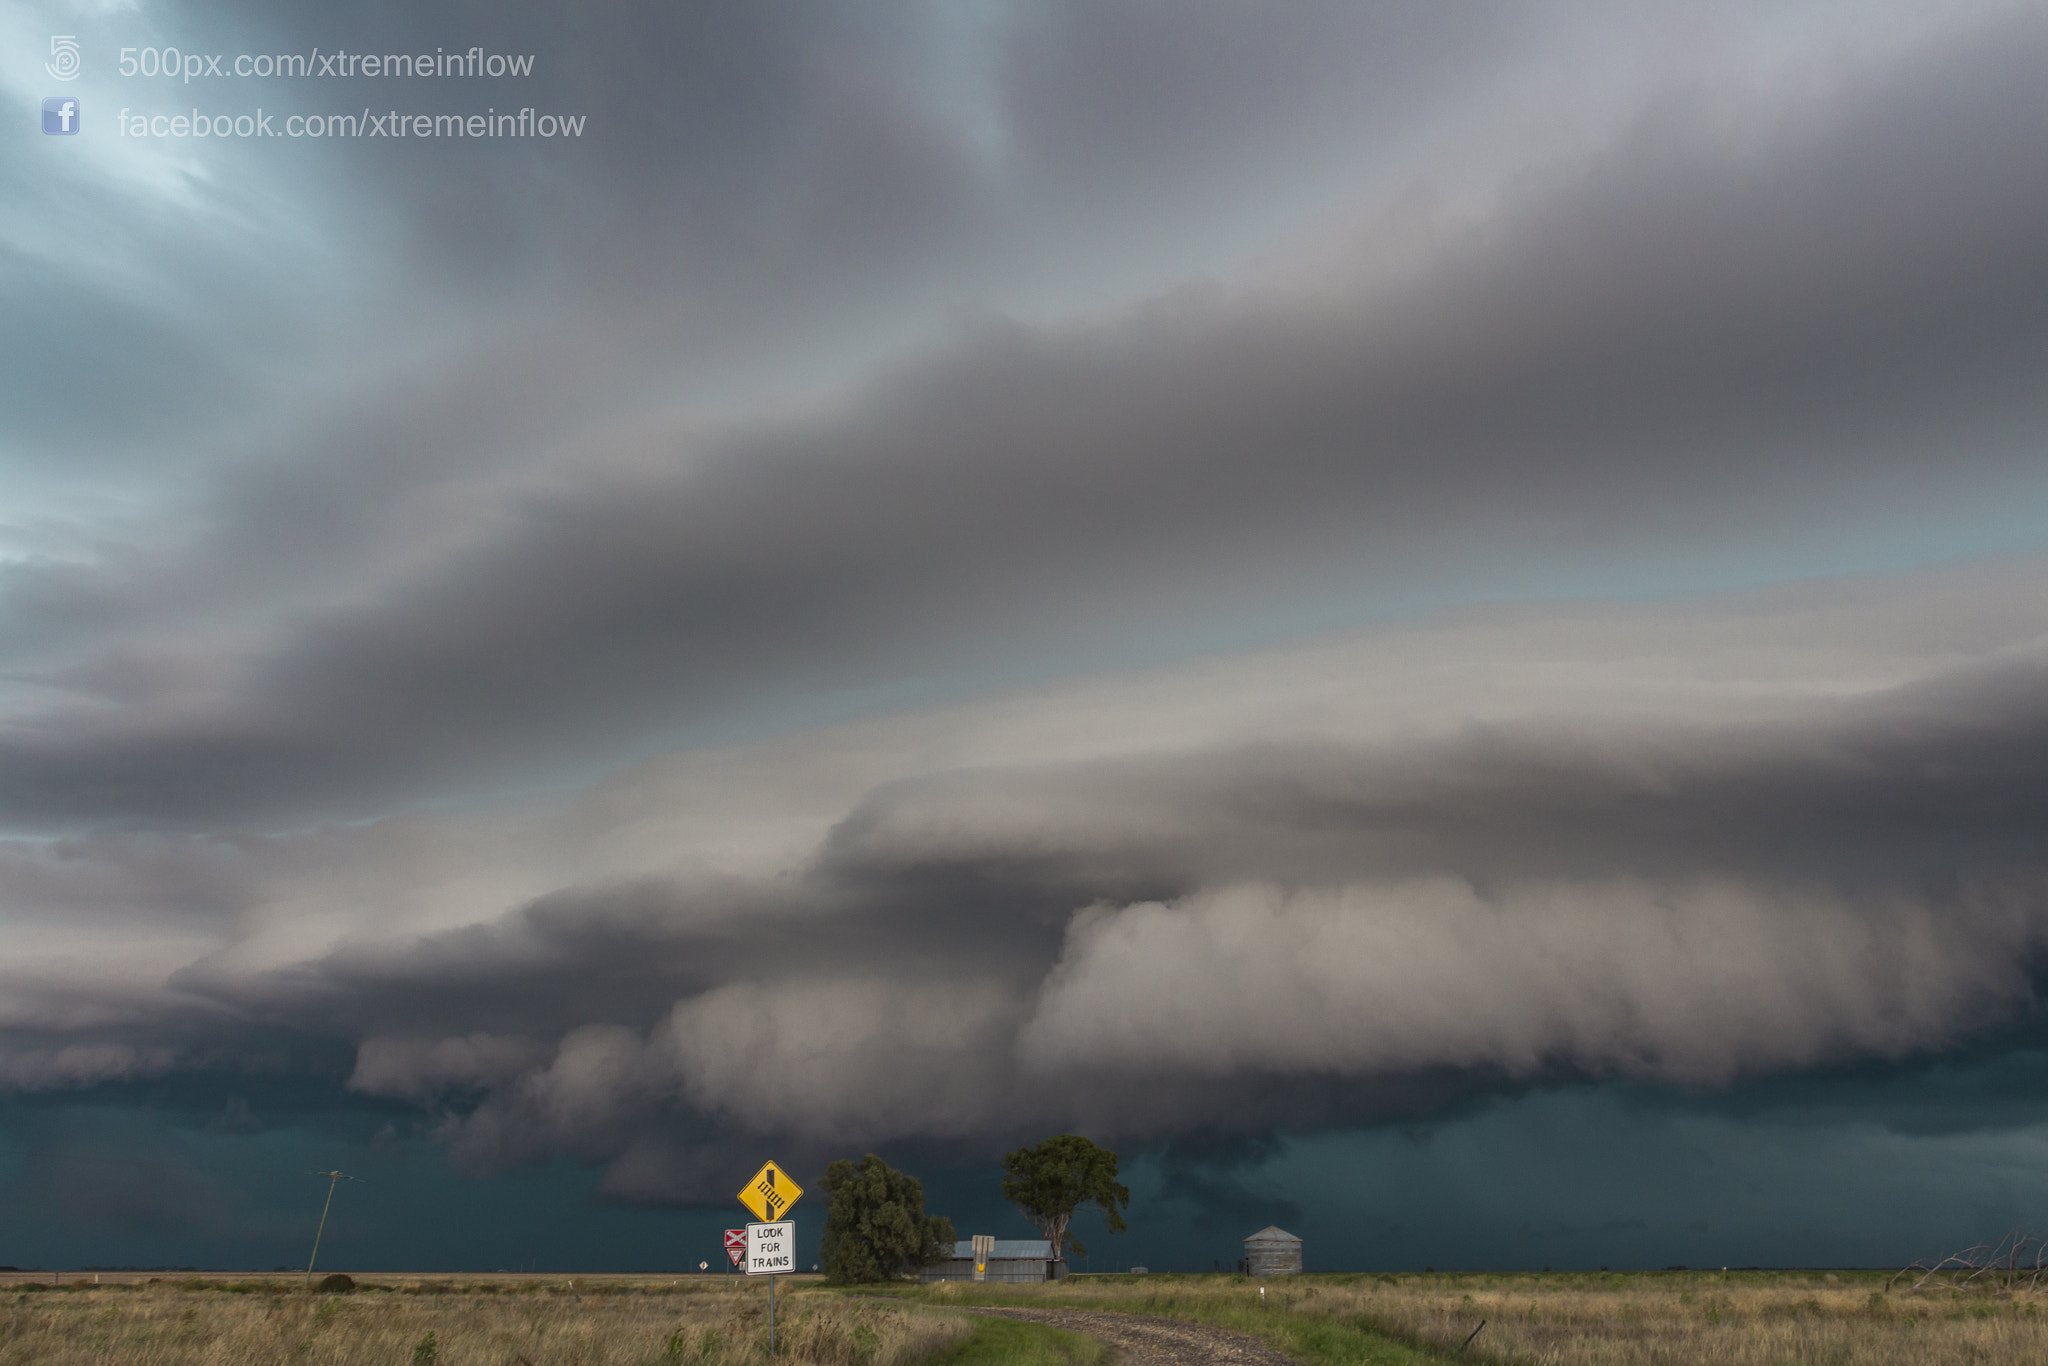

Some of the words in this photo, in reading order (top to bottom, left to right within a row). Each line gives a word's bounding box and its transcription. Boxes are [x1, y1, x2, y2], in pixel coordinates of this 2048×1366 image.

[757, 1227, 784, 1239] LOOK
[760, 1242, 780, 1253] FOR
[752, 1255, 790, 1268] TRAINS
